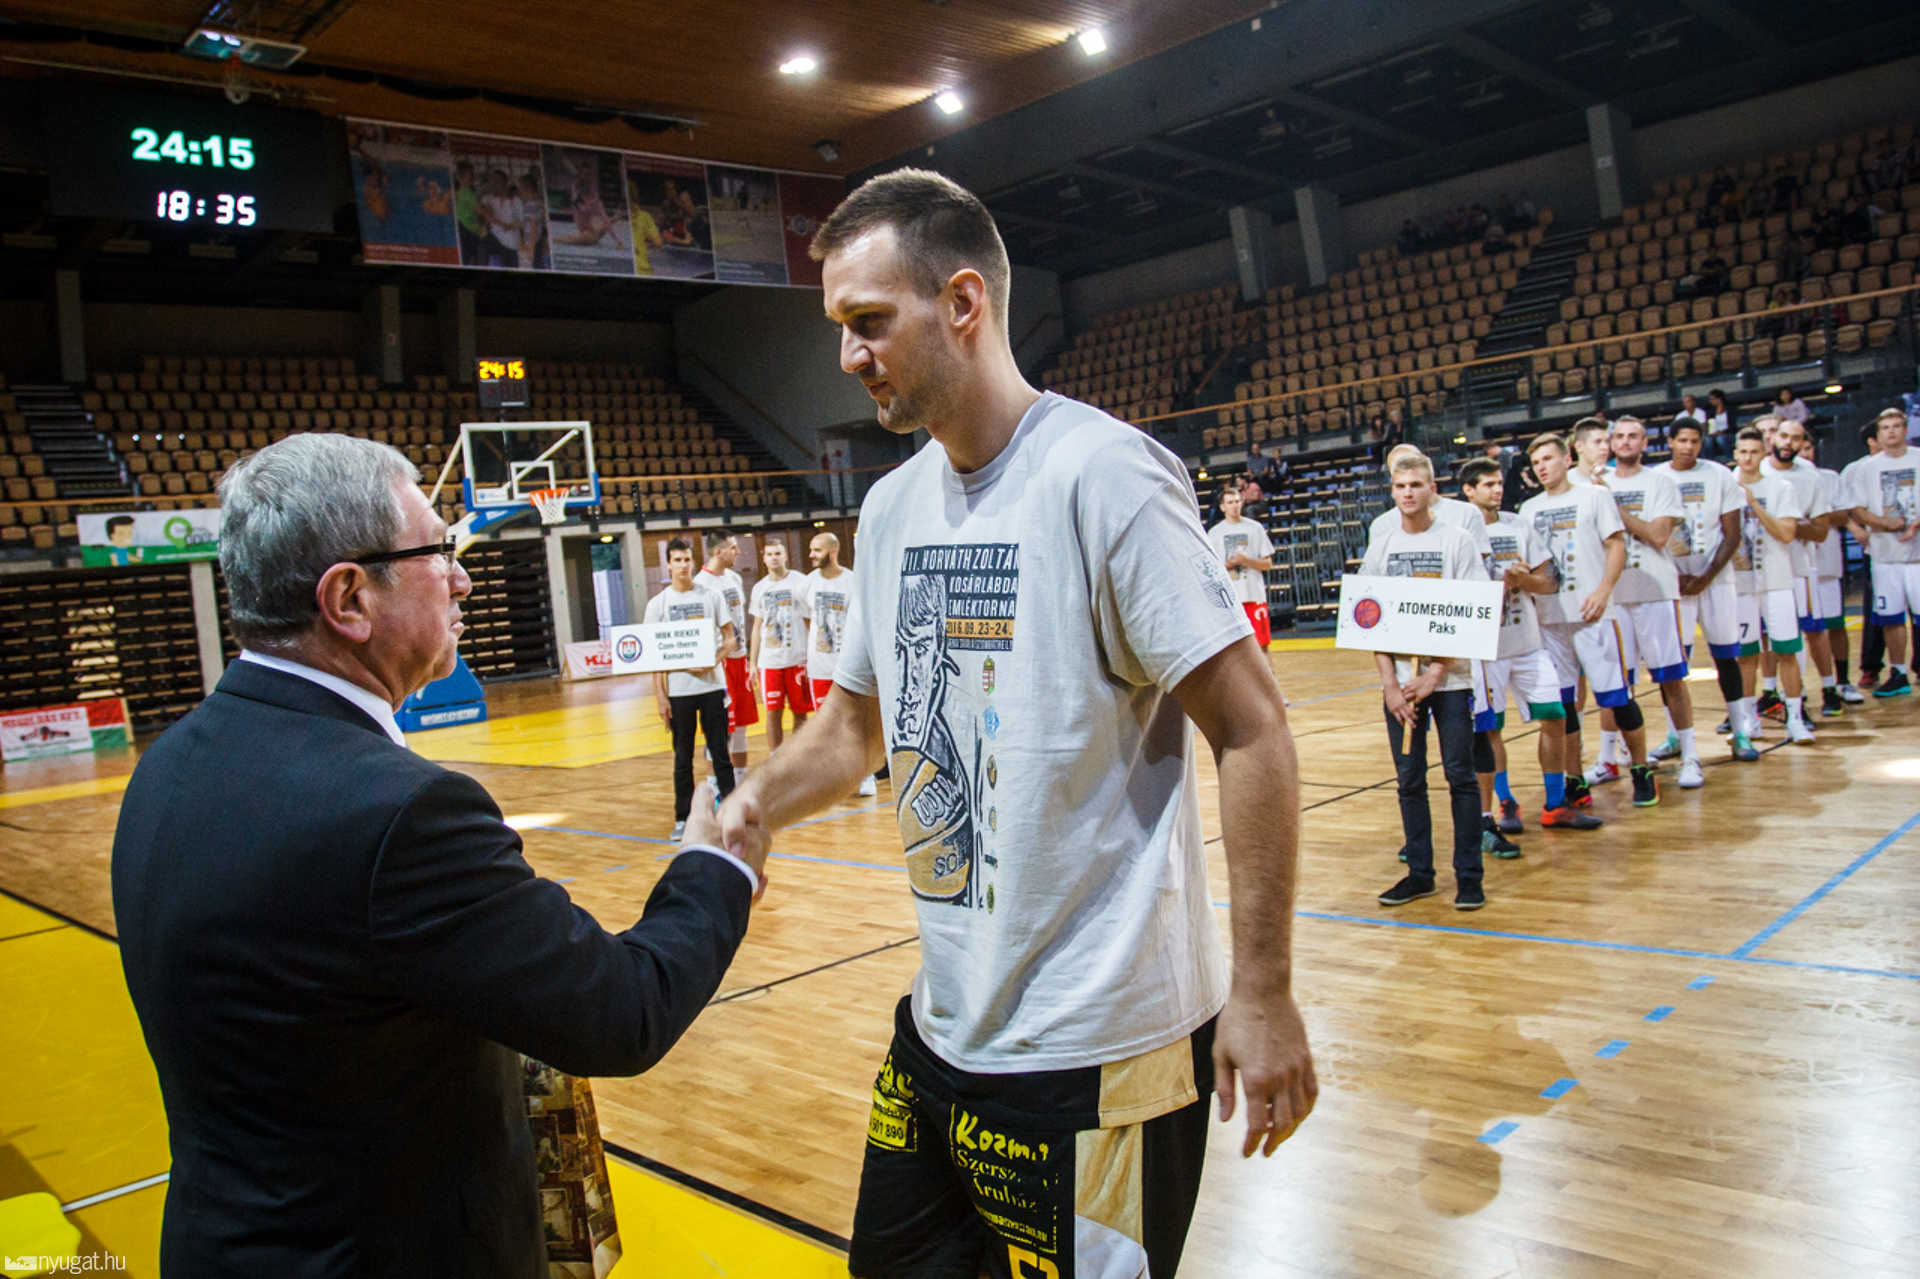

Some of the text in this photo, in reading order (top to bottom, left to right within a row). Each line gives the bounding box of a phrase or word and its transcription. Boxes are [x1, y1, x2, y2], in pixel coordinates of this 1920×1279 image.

[130, 127, 256, 170] 24:15
[479, 360, 525, 380] 24:15
[921, 545, 972, 571] HORVÁTH
[1476, 606, 1493, 620] SE
[1428, 621, 1456, 635] Paks
